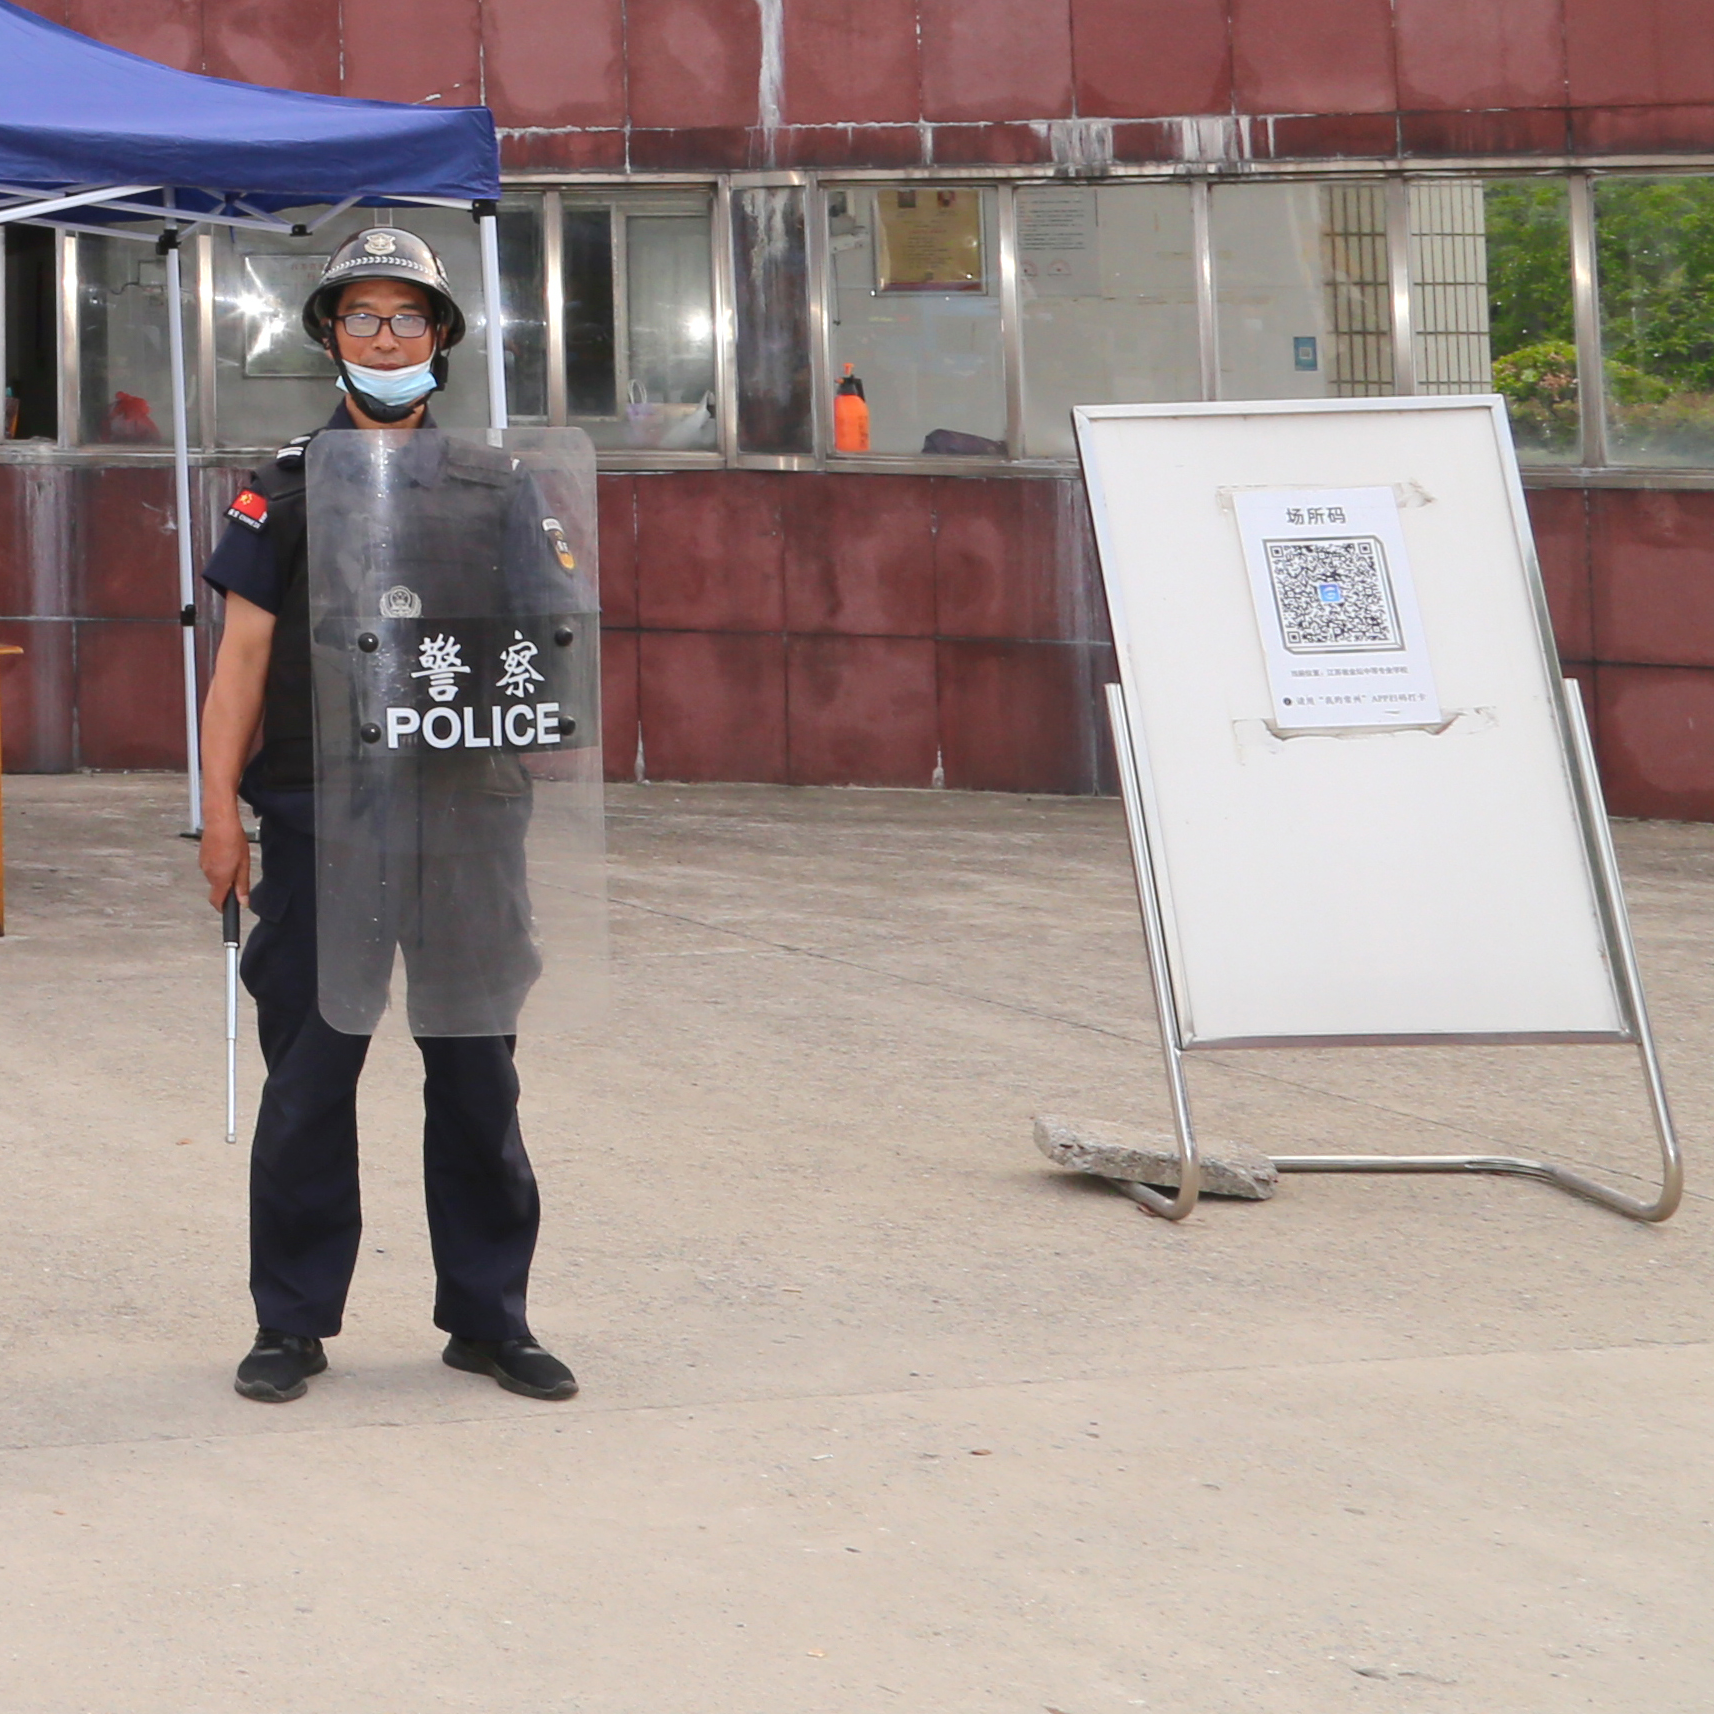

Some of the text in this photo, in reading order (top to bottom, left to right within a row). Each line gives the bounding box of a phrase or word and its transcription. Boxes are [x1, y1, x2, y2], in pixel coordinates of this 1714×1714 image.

[1286, 505, 1347, 527] 场所码
[411, 630, 545, 703] 警察
[386, 702, 561, 750] POLICE
